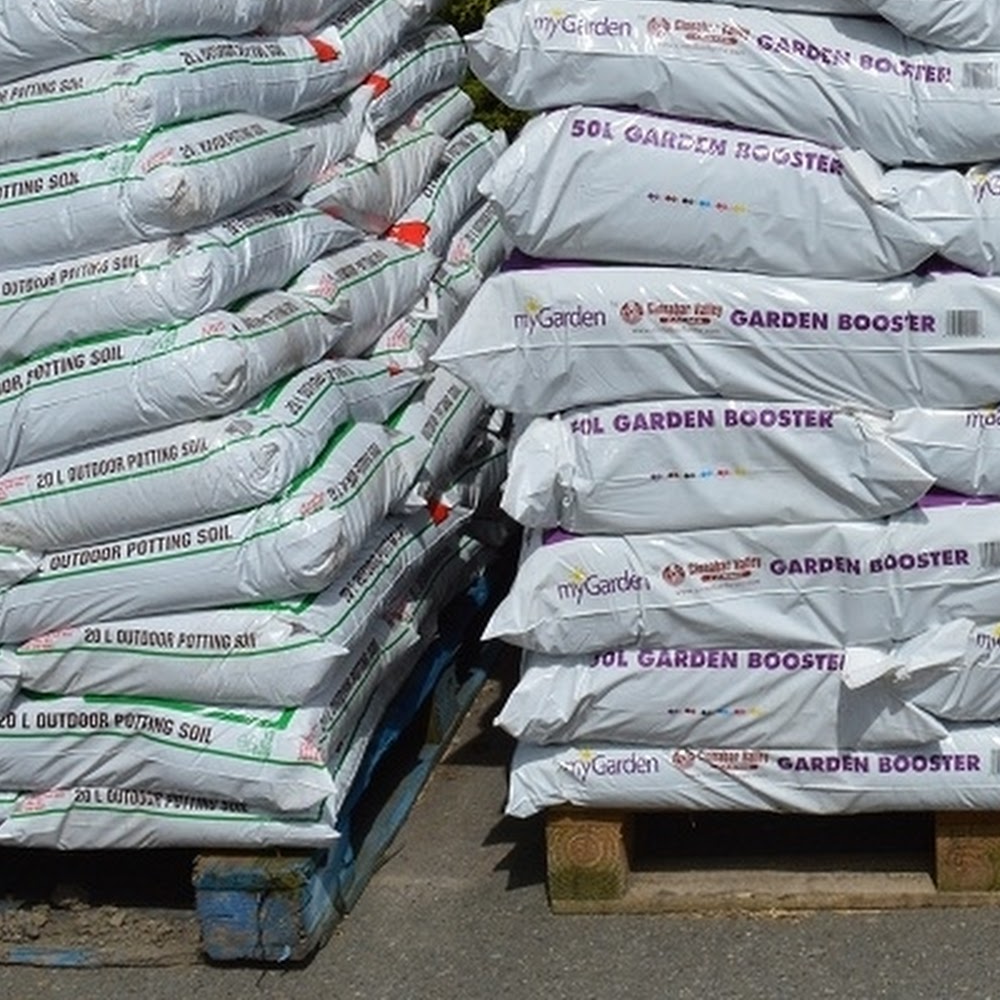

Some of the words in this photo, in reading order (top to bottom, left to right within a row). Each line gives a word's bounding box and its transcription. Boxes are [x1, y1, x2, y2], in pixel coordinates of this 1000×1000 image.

[535, 13, 632, 38] myGarden
[757, 34, 851, 67] GARDEN
[860, 52, 952, 84] BOOSTER
[570, 119, 615, 141] 50L
[625, 125, 727, 156] GARDEN
[735, 139, 845, 176] BOOSTER
[2, 272, 57, 297] OUTDOOR
[59, 262, 109, 282] POTTING
[112, 254, 140, 270] SOIL
[514, 306, 606, 335] myGarden
[729, 310, 828, 331] GARDEN
[837, 312, 936, 333] BOOSTER
[26, 356, 85, 385] POTTING
[89, 345, 124, 365] SOIL
[613, 411, 715, 434] GARDEN
[724, 408, 834, 430] BOOSTER
[36, 474, 54, 489] 20
[57, 470, 63, 483] L
[68, 459, 126, 483] OUTDOOR
[127, 448, 179, 471] POTTING
[182, 438, 209, 458] SOIL
[50, 545, 122, 571] OUTDOOR
[126, 532, 192, 560] POTTING
[196, 523, 233, 544] SOIL
[558, 569, 651, 603] myGarden
[770, 556, 861, 577] GARDEN
[869, 549, 970, 575] BOOSTER
[85, 628, 101, 642] 20
[105, 629, 113, 643] L
[117, 629, 174, 648] OUTDOOR
[177, 631, 231, 650] POTTING
[638, 649, 738, 670] GARDEN
[22, 713, 31, 729] L
[36, 713, 109, 729] OUTDOOR
[114, 713, 173, 736] POTTING
[178, 723, 213, 745] SOIL
[777, 754, 870, 774] GARDEN
[879, 753, 981, 774] BOOSTER
[74, 788, 91, 803] 20
[107, 789, 164, 808] OUTDOOR
